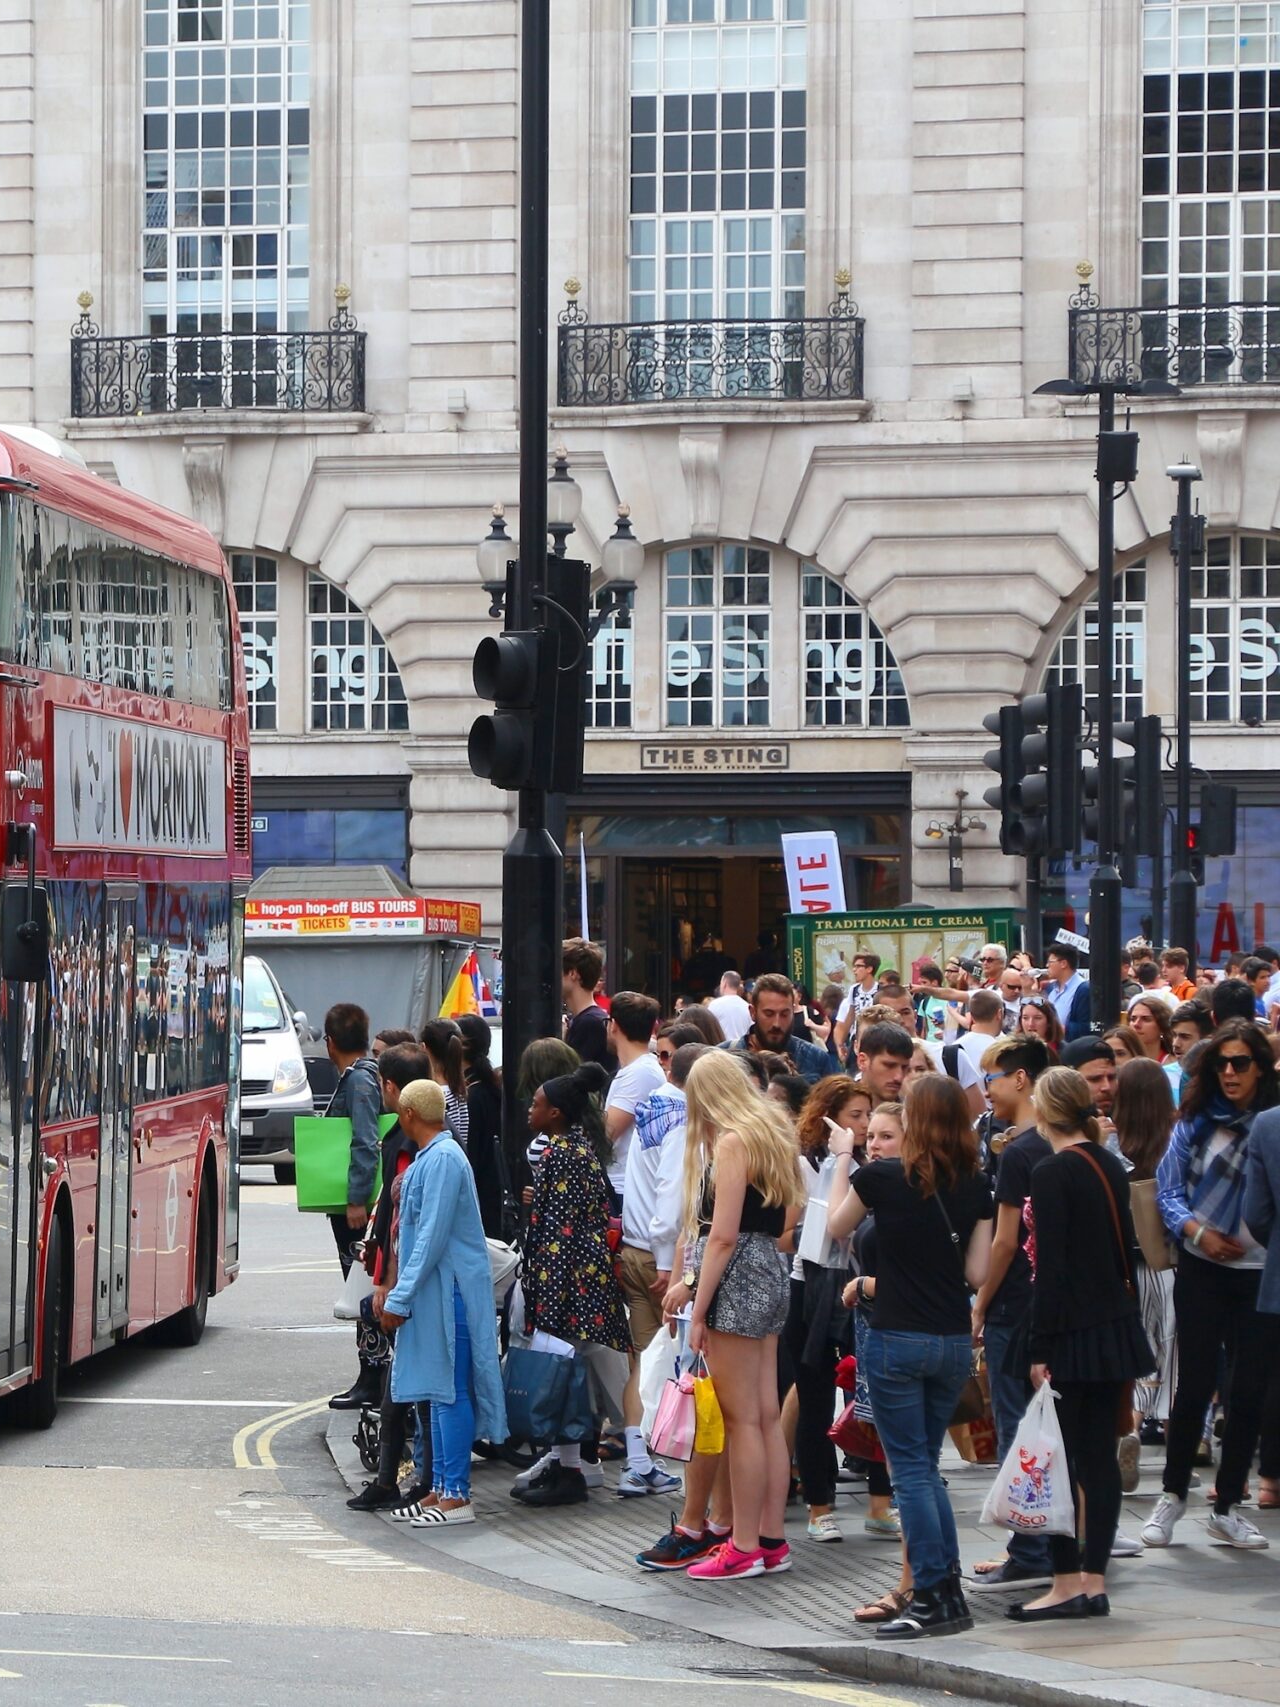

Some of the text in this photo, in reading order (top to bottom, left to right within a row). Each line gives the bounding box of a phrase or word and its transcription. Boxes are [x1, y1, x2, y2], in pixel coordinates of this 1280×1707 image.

[647, 748, 782, 764] THE STING
[261, 903, 302, 917] hop-on
[306, 902, 348, 916] hop-off
[351, 901, 375, 913] BUS
[378, 901, 416, 913] TOURS
[302, 917, 345, 930] TICKETS
[428, 918, 438, 931] BUS
[439, 919, 457, 933] TOURS
[815, 916, 984, 930] TRADITIONAL ICE CREAM
[1008, 1510, 1048, 1526] TESCO
